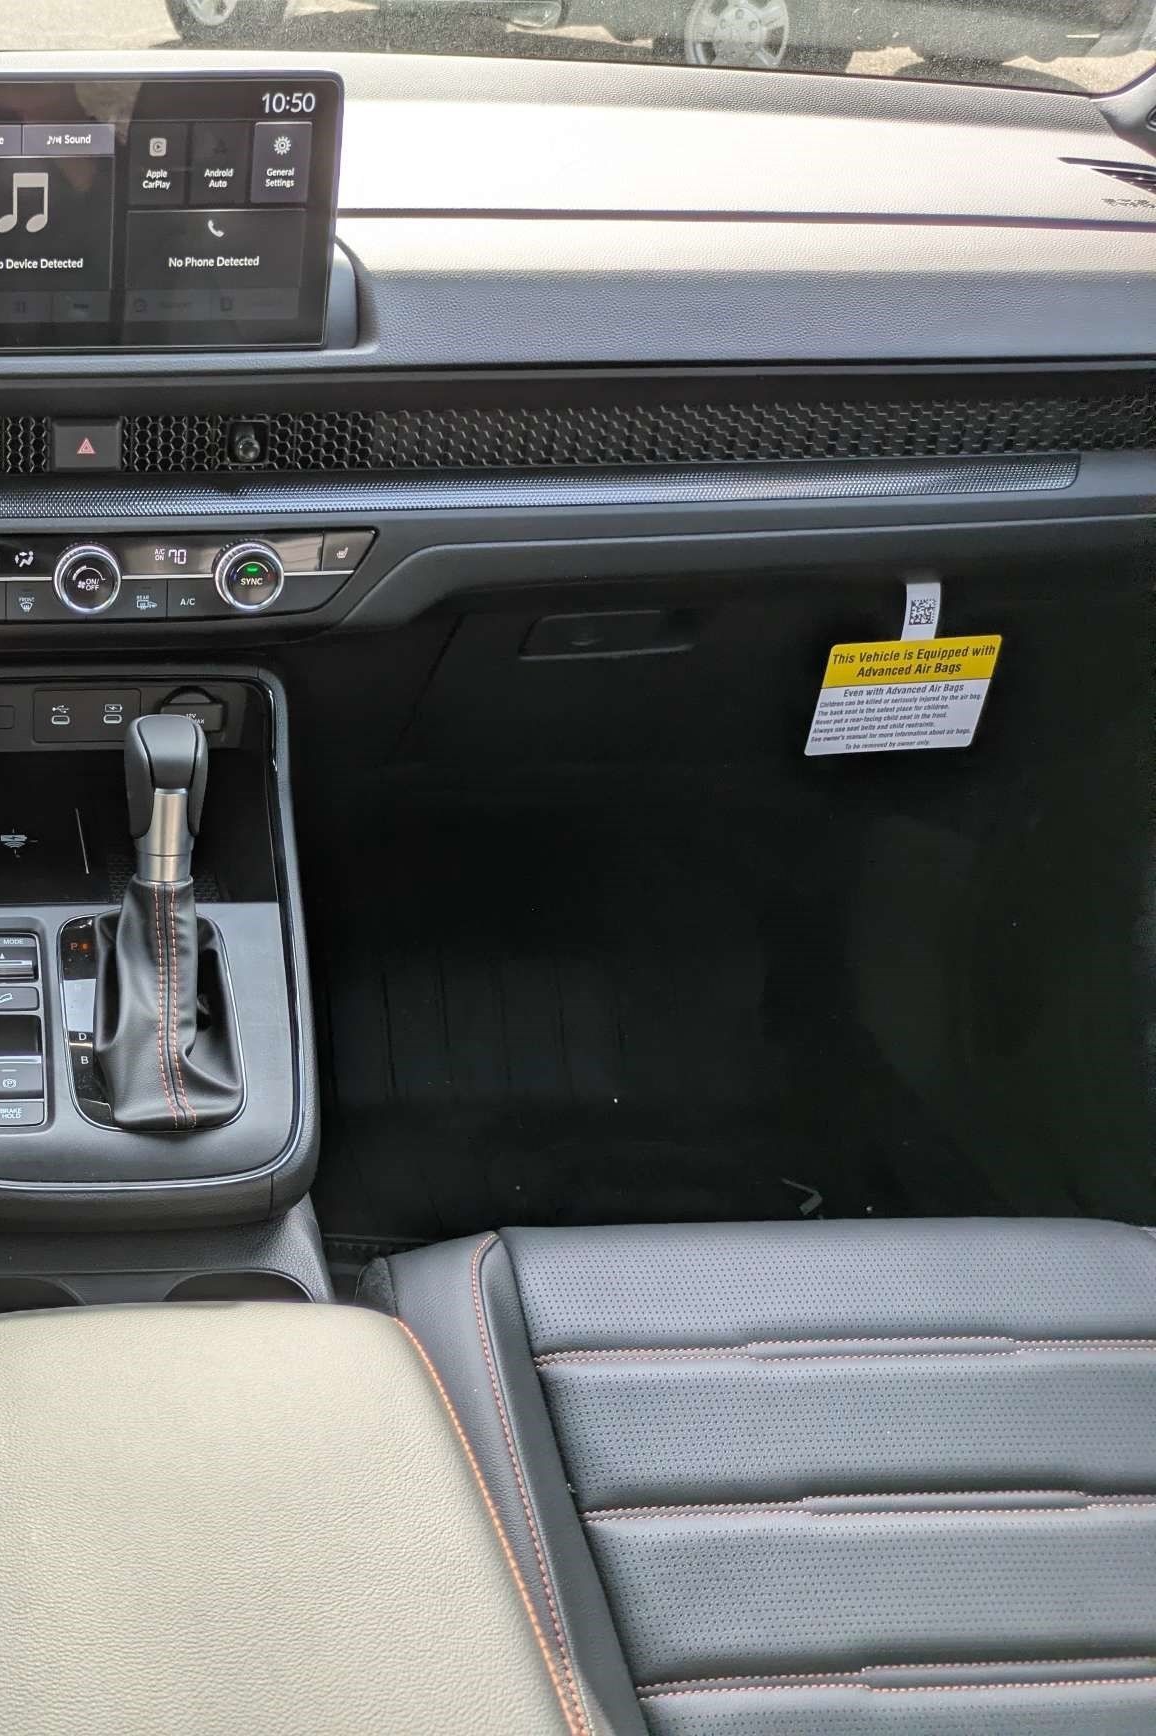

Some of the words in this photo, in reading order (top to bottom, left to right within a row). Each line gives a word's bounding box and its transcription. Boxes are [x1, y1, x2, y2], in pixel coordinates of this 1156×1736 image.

[262, 92, 315, 113] 10:50
[64, 134, 91, 144] Sound
[146, 169, 167, 179] Apple
[204, 168, 233, 177] Android
[266, 167, 294, 177] General
[142, 180, 170, 190] CarPlay
[209, 179, 227, 188] Auto
[265, 178, 294, 188] Settings
[6, 259, 38, 269] Device
[40, 258, 83, 269] Detected
[168, 257, 183, 267] No
[185, 257, 214, 267] Phone
[216, 256, 260, 266] Detected
[168, 549, 186, 564] 70
[240, 577, 263, 586] SYNC
[180, 598, 195, 606] A/C
[832, 654, 855, 665] This
[859, 651, 900, 663] Vehicle
[904, 649, 914, 660] is
[916, 647, 970, 661] Equipped
[972, 645, 996, 657] with
[857, 664, 911, 677] Advanced
[914, 664, 931, 675] Air
[934, 662, 962, 674] Bags
[844, 689, 864, 698] Even
[866, 687, 884, 696] with
[885, 685, 927, 696] Advanced
[928, 684, 942, 692] Air
[943, 684, 964, 693] Bags
[78, 1033, 87, 1041] D
[81, 1056, 89, 1065] B
